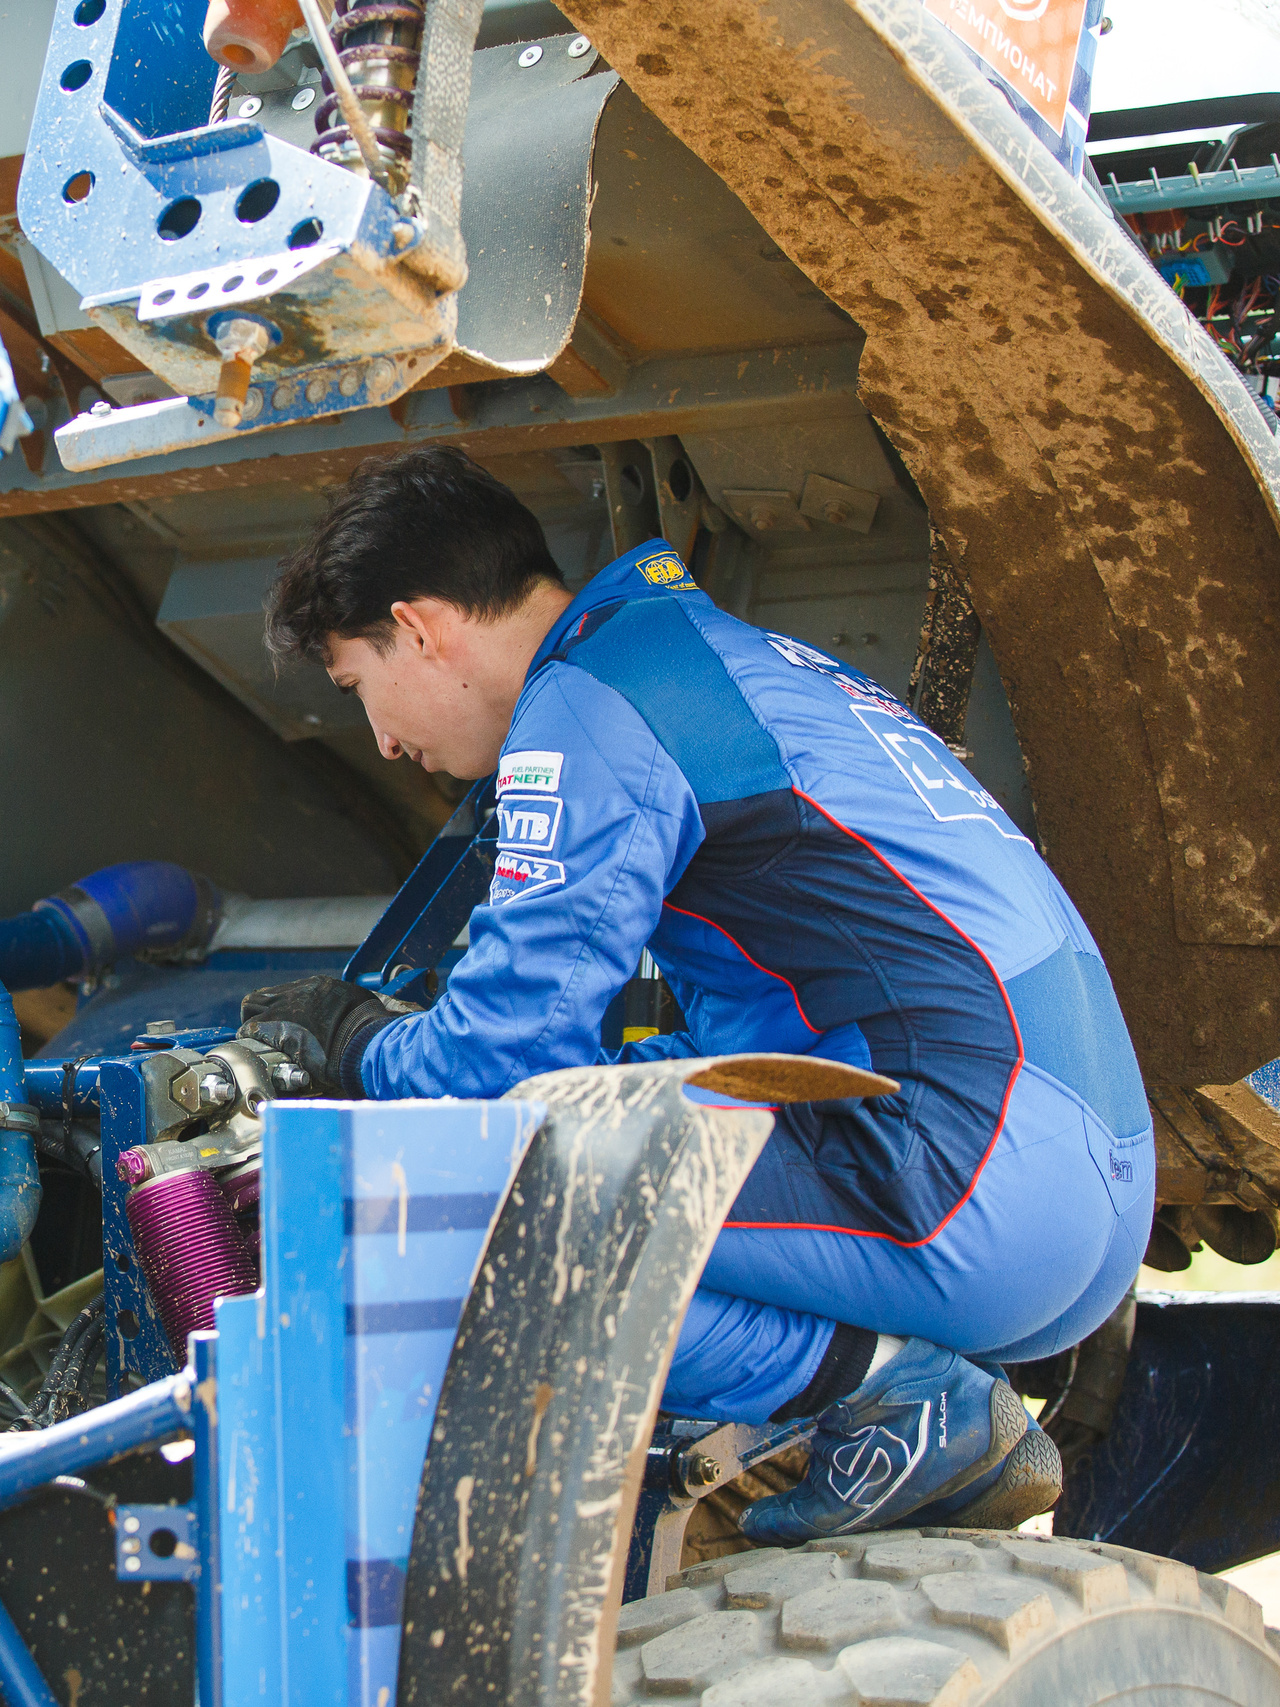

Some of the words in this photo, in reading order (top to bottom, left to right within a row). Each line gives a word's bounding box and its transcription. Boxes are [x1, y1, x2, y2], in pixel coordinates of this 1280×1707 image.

[949, 0, 1057, 102] ЕМПИОНАТ
[647, 560, 682, 583] FIA
[525, 766, 555, 774] PARTNER
[503, 810, 550, 841] VTB
[499, 856, 549, 880] AMAZ
[939, 1391, 948, 1448] SLALOM
